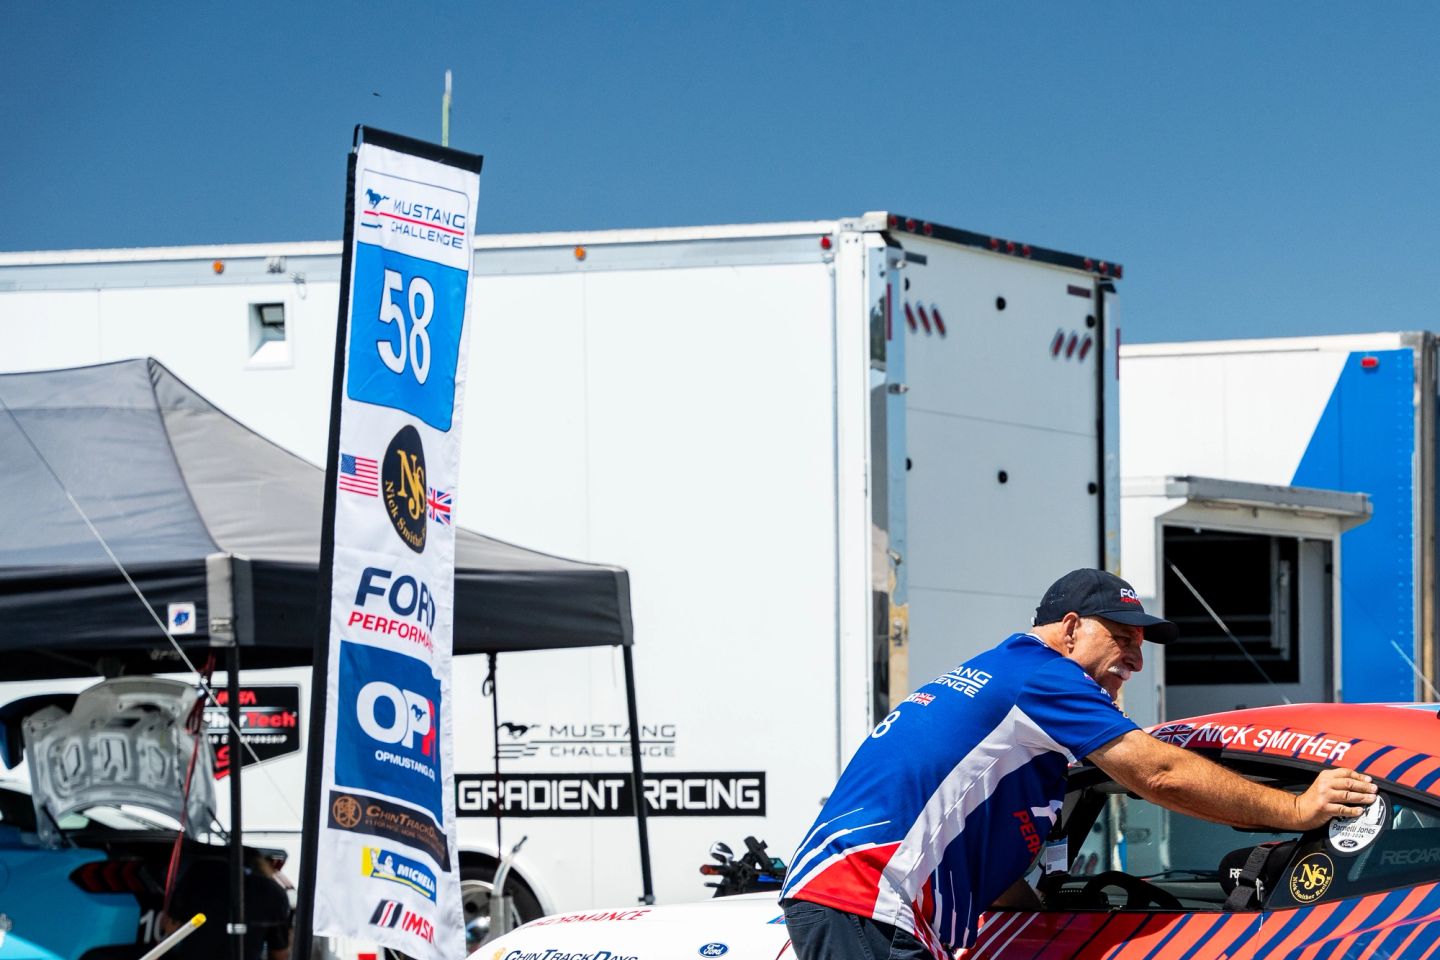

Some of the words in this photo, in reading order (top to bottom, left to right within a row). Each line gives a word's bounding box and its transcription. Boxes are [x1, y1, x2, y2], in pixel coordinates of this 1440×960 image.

[393, 199, 466, 230] MUSTANG
[391, 221, 465, 249] CHALLENGE
[377, 268, 435, 385] 58
[1198, 723, 1255, 746] NICK
[1254, 729, 1352, 761] SMITHER
[458, 779, 625, 811] GRADIENT
[643, 779, 760, 809] RACING
[1358, 827, 1375, 835] Jones
